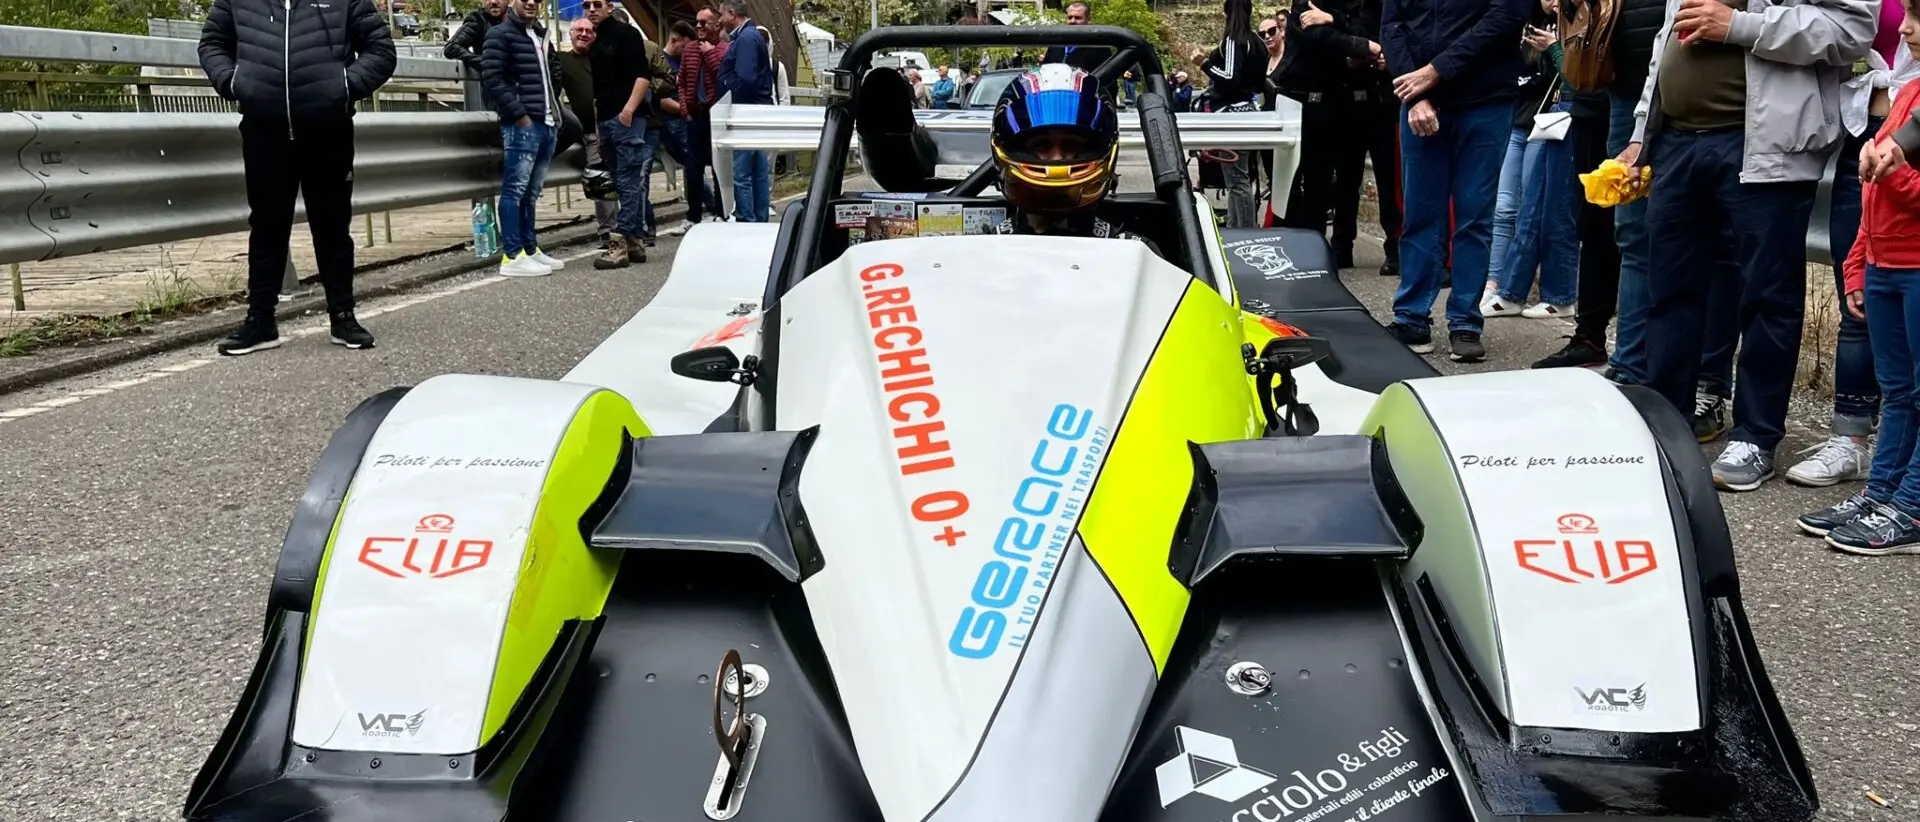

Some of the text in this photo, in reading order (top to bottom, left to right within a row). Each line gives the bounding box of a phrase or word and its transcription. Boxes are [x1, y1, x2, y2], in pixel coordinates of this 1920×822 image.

[859, 263, 955, 476] G.RECHICHI
[372, 454, 545, 469] Piloti per passione
[1460, 454, 1645, 470] Piloti per passione
[357, 536, 494, 579] ELIA
[1007, 425, 1110, 649] IL TUO PARTNER NEI TRASPORTI
[1513, 539, 1658, 584] ELIA
[1336, 752, 1367, 773] &
[1358, 726, 1410, 762] figli
[1339, 788, 1365, 806] edili
[1367, 759, 1419, 792] colorificio
[1369, 788, 1412, 816] cliente
[1407, 766, 1450, 798] finale
